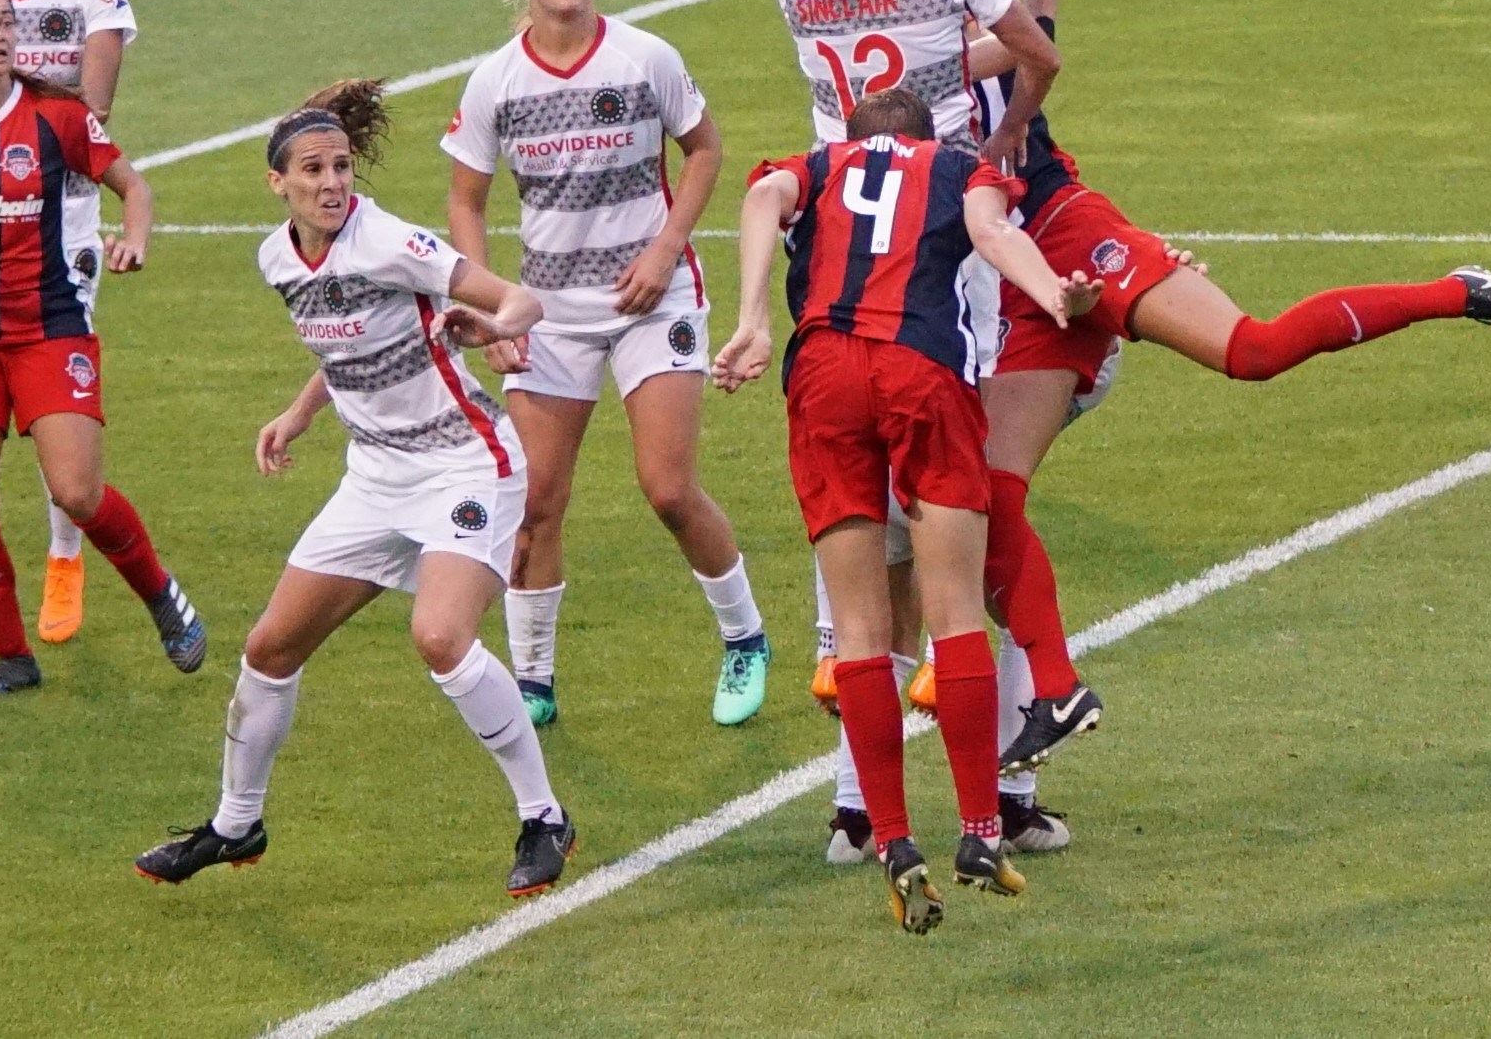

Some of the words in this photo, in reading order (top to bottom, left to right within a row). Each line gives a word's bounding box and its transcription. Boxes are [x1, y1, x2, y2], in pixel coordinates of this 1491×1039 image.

[16, 50, 80, 67] DENCE
[814, 31, 907, 122] 12
[516, 131, 635, 159] PROVIDENCE
[848, 134, 917, 159] UINN
[842, 166, 904, 255] 4
[298, 320, 366, 339] OVIDENCE
